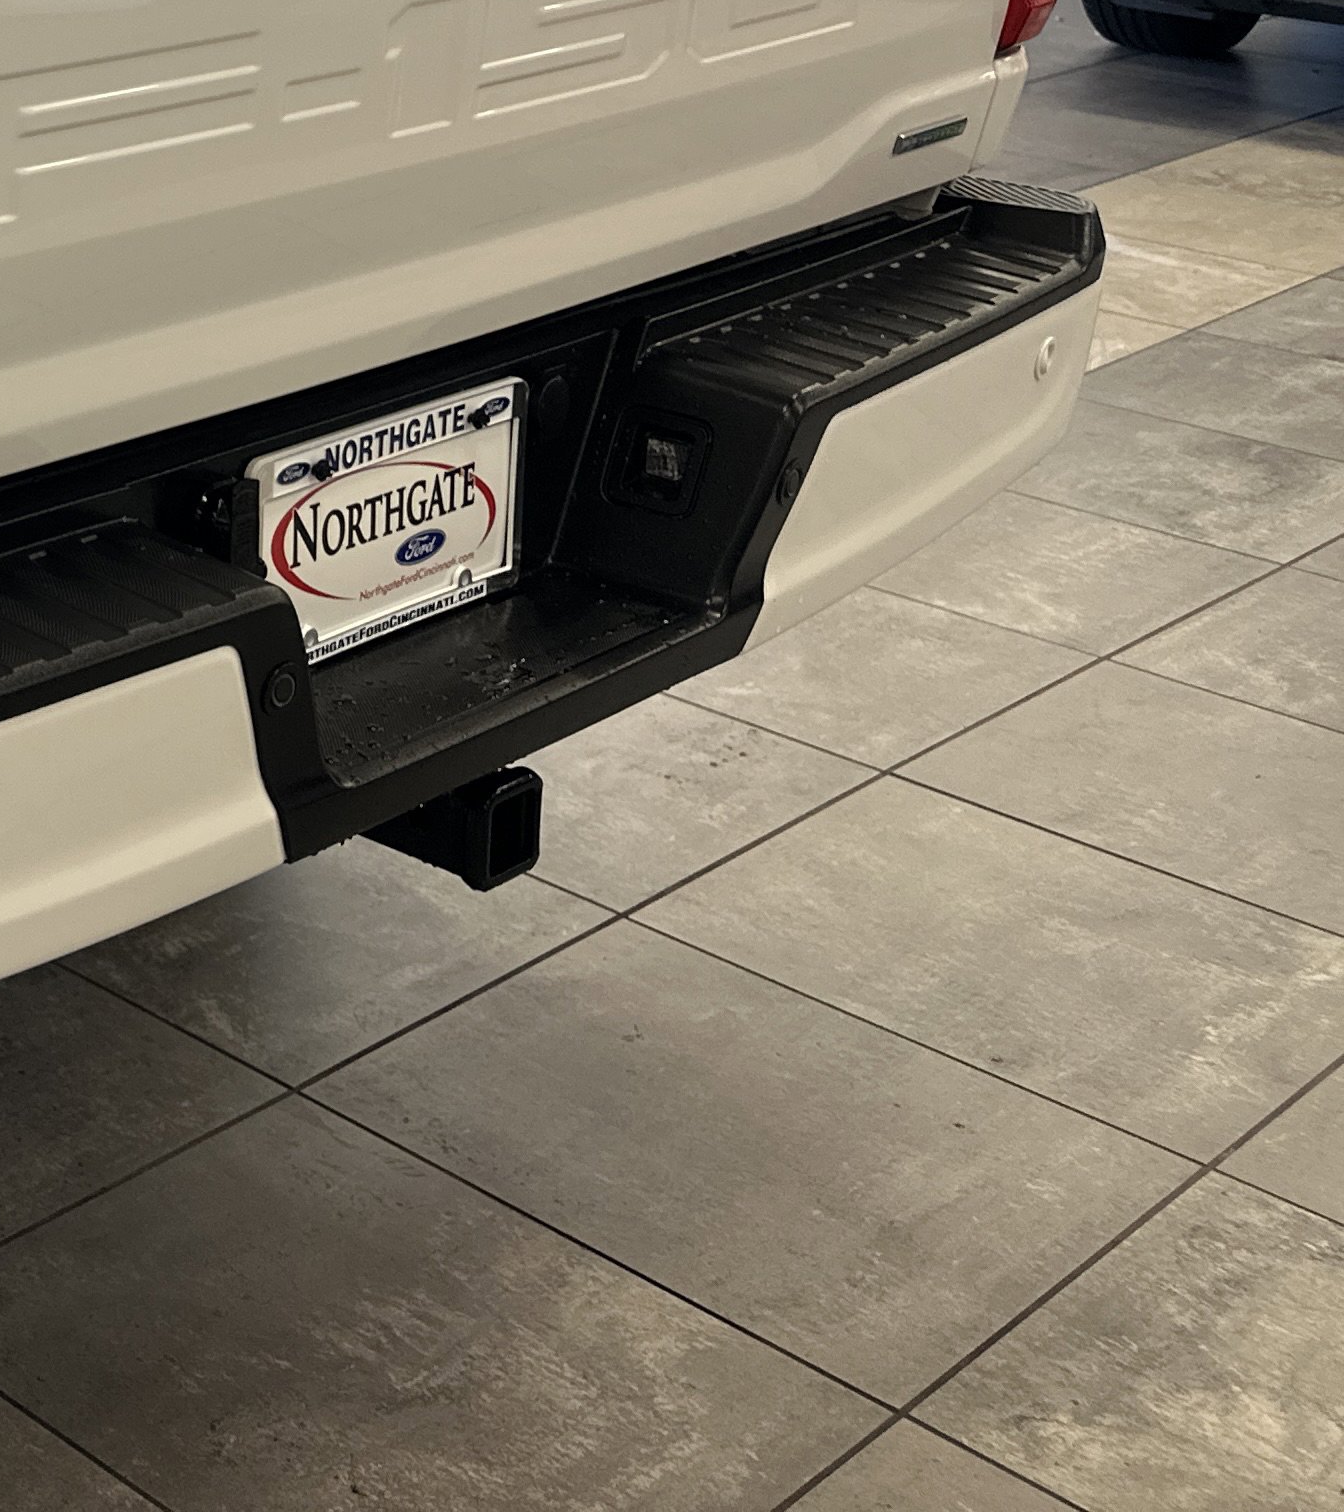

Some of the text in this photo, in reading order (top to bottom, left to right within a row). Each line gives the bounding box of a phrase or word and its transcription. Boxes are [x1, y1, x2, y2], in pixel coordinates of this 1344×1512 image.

[323, 403, 467, 473] NORTHGATE
[288, 461, 476, 569] NORTHGATE
[403, 531, 439, 562] Ford
